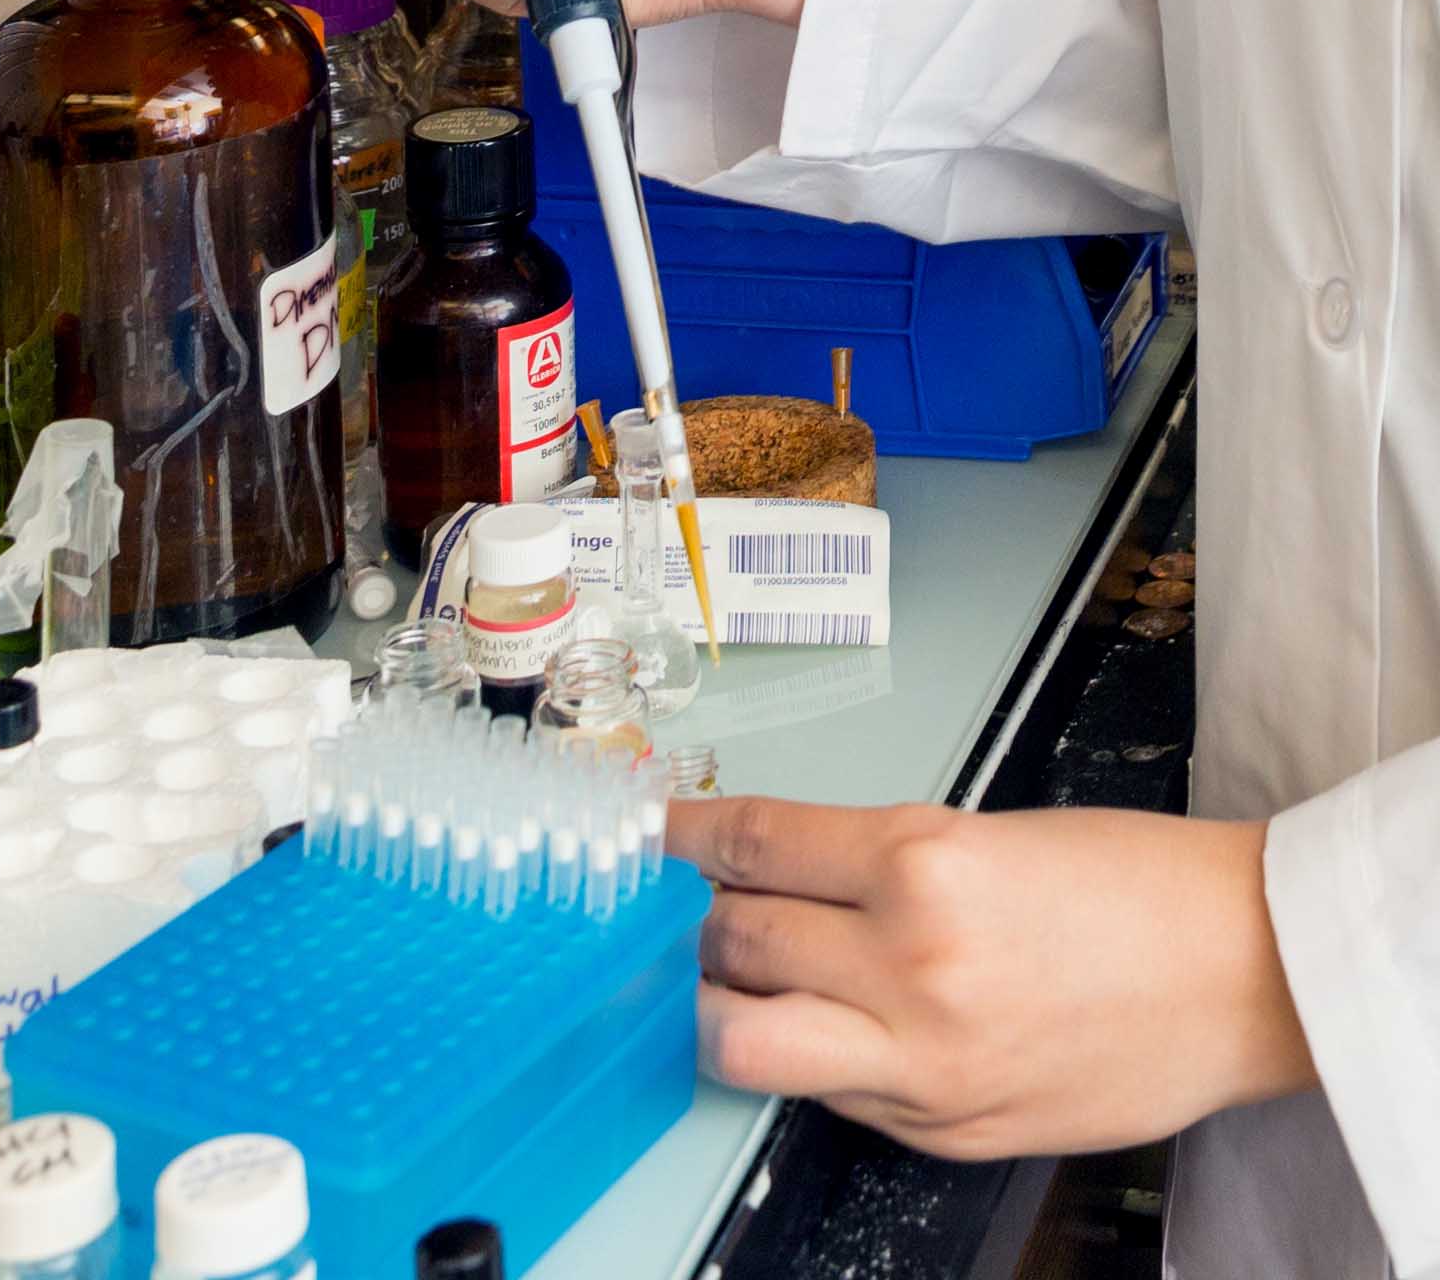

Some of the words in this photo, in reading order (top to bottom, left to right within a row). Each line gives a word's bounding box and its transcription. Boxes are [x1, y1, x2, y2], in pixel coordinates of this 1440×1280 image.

[381, 174, 404, 195] 200
[383, 222, 405, 240] 150
[530, 363, 561, 385] ALDRICH
[570, 532, 614, 552] inge
